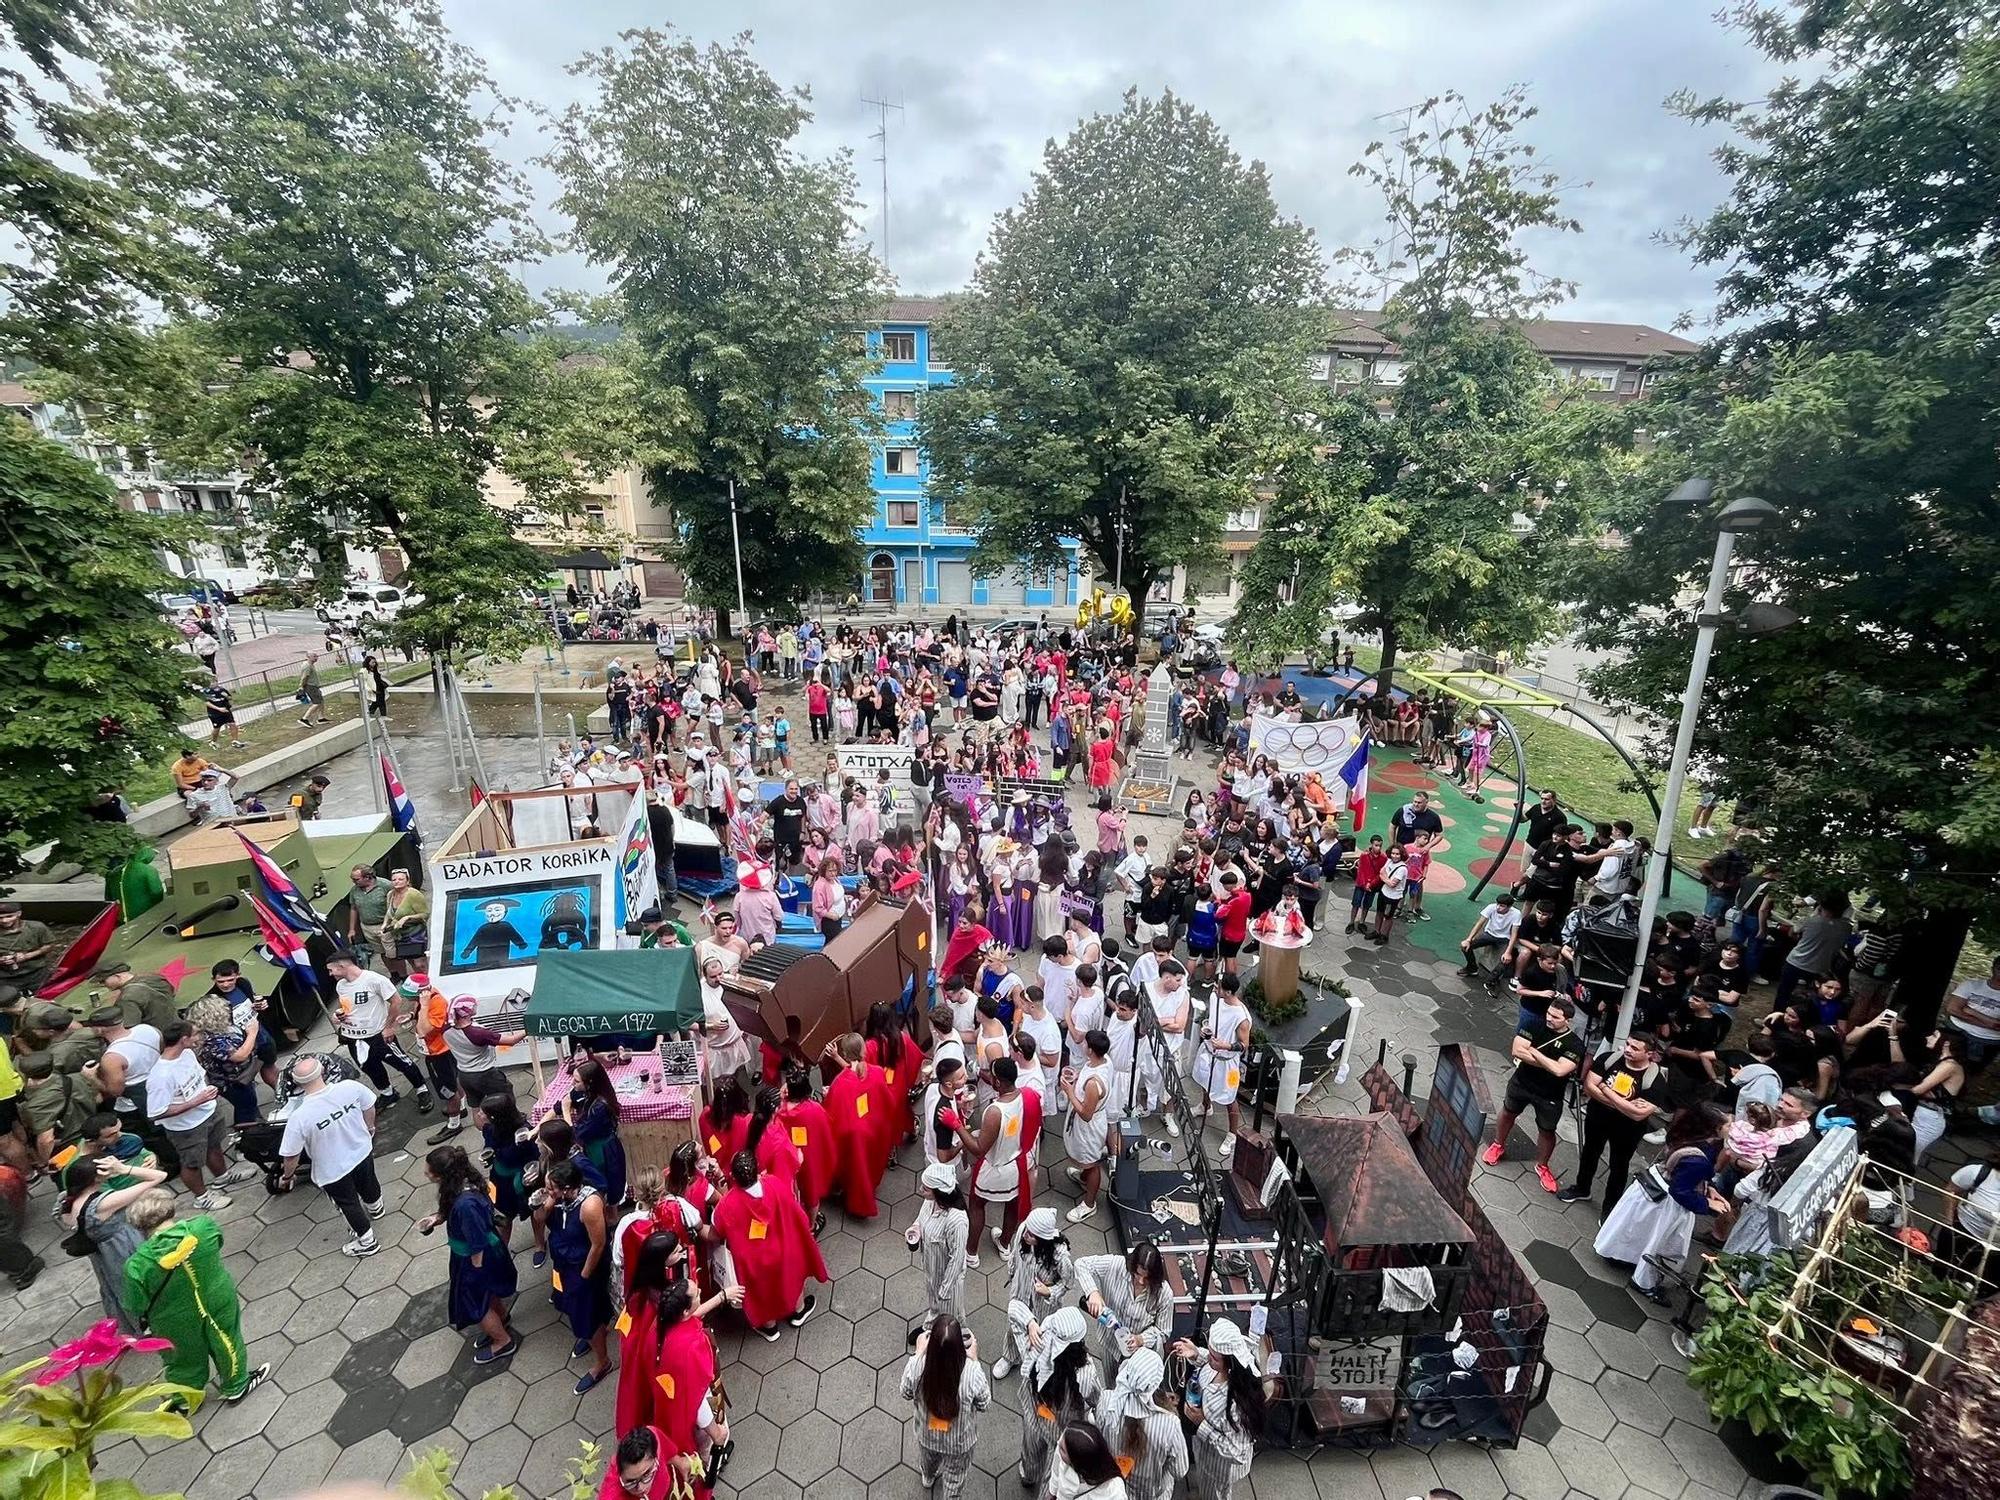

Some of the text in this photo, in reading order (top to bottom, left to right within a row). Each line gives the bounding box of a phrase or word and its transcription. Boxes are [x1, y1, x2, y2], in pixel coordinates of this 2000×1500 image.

[845, 755, 913, 768] ATOTXA
[946, 776, 972, 784] VOTES
[443, 858, 533, 880] BADATOR
[538, 1013, 657, 1033] ALGORTA 1972
[316, 1103, 357, 1130] bbk
[1330, 1354, 1388, 1369] HALT!
[1330, 1368, 1386, 1384] STOJ!
